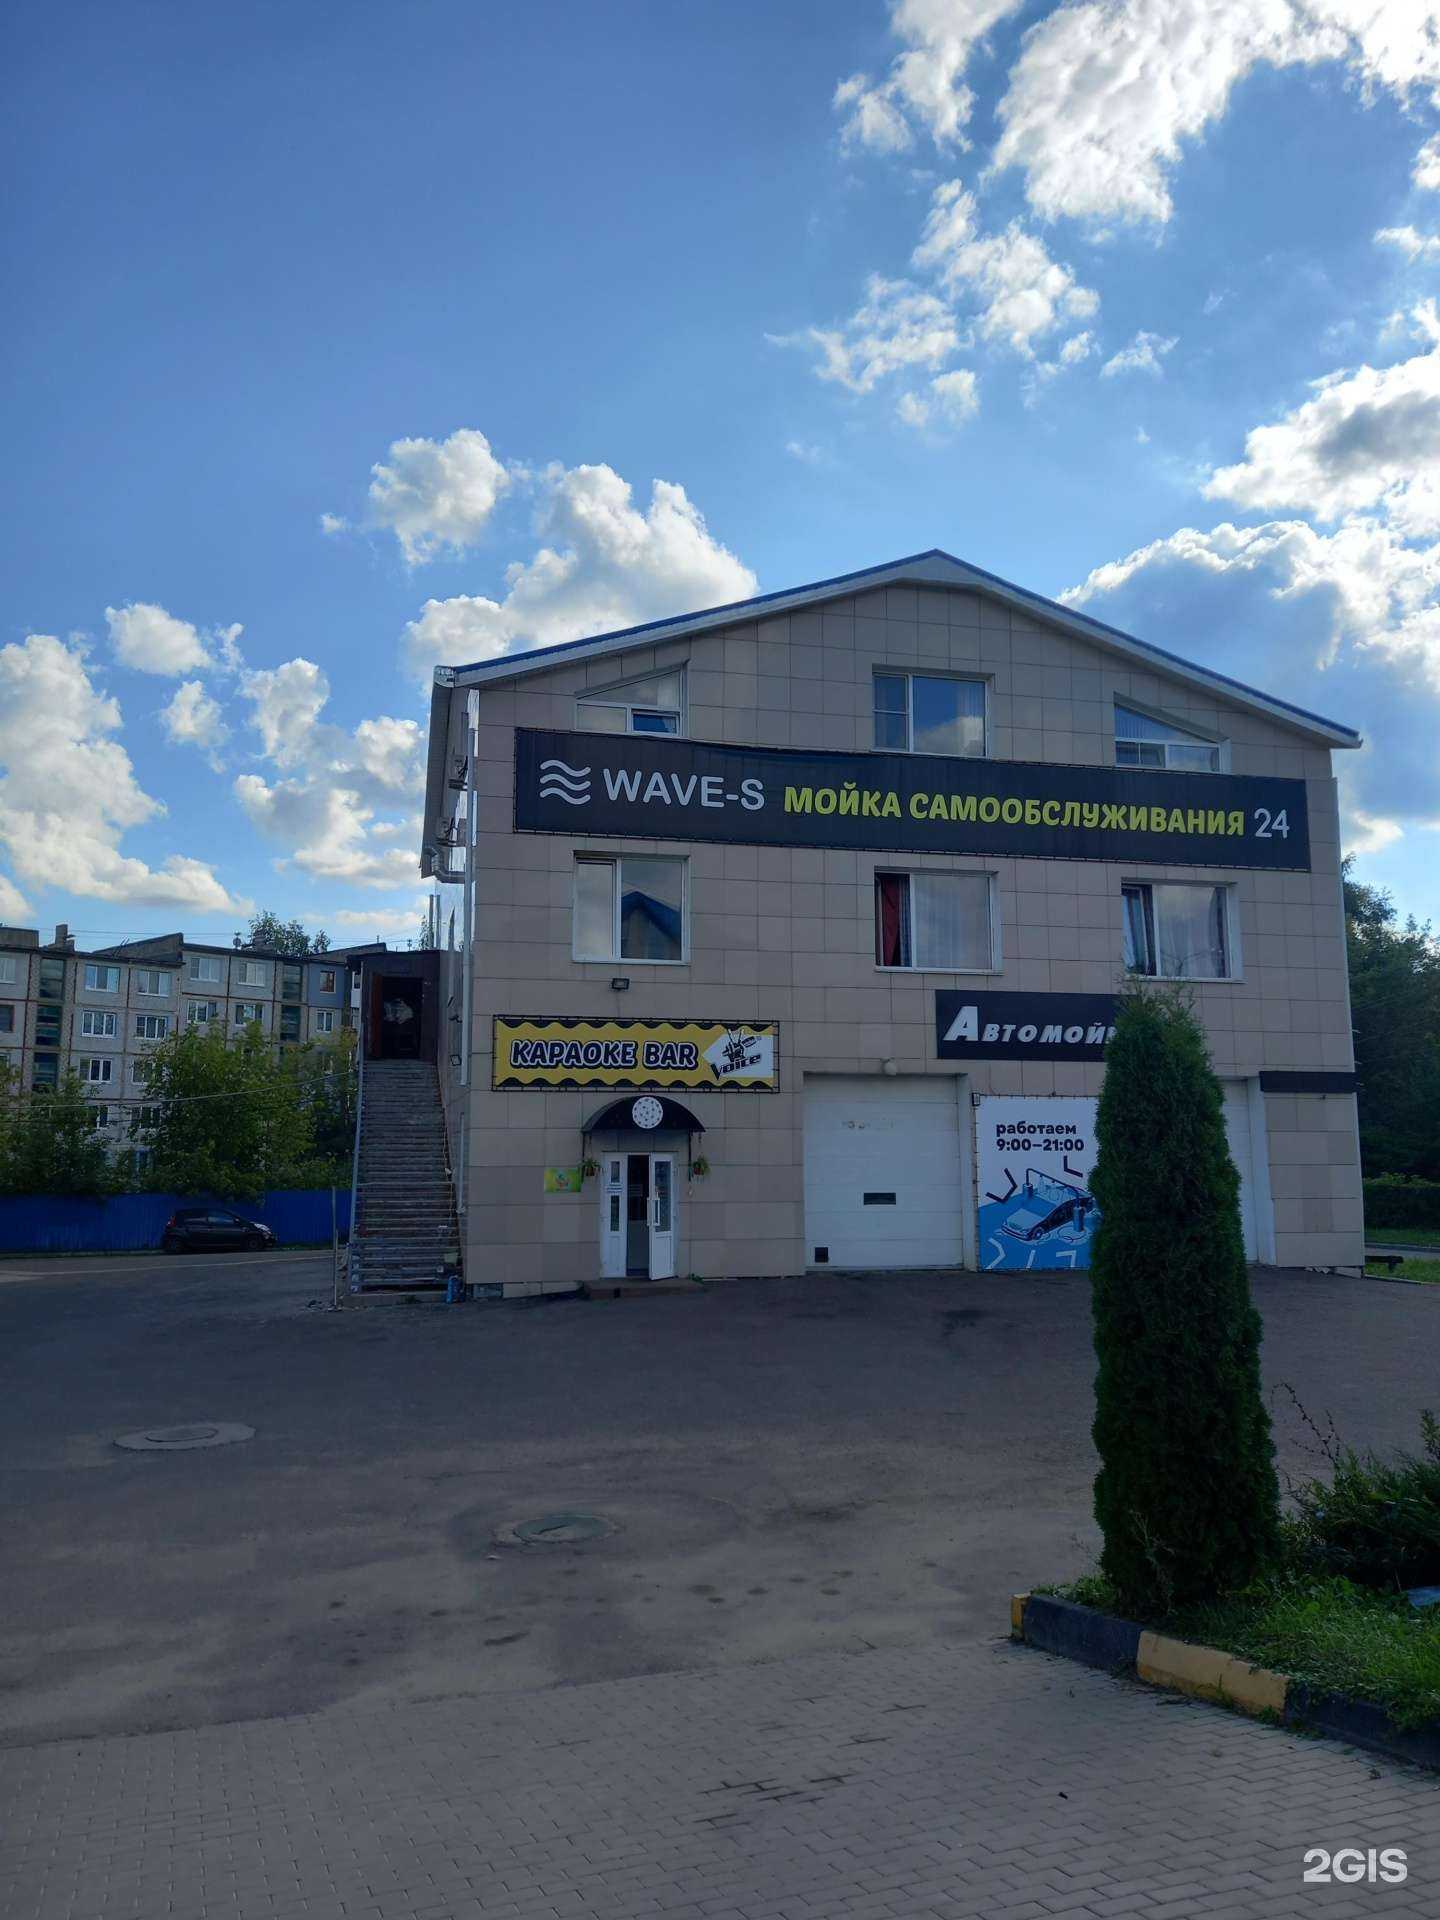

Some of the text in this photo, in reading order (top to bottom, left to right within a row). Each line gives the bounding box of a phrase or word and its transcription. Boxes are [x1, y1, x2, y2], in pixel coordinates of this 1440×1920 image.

[603, 768, 1290, 839] WAVE-S МОЙКА САМООБСЛУЖИВАНИЯ 24
[511, 1039, 698, 1070] КАРАОКЕ BAR
[995, 1121, 1077, 1137] работаем
